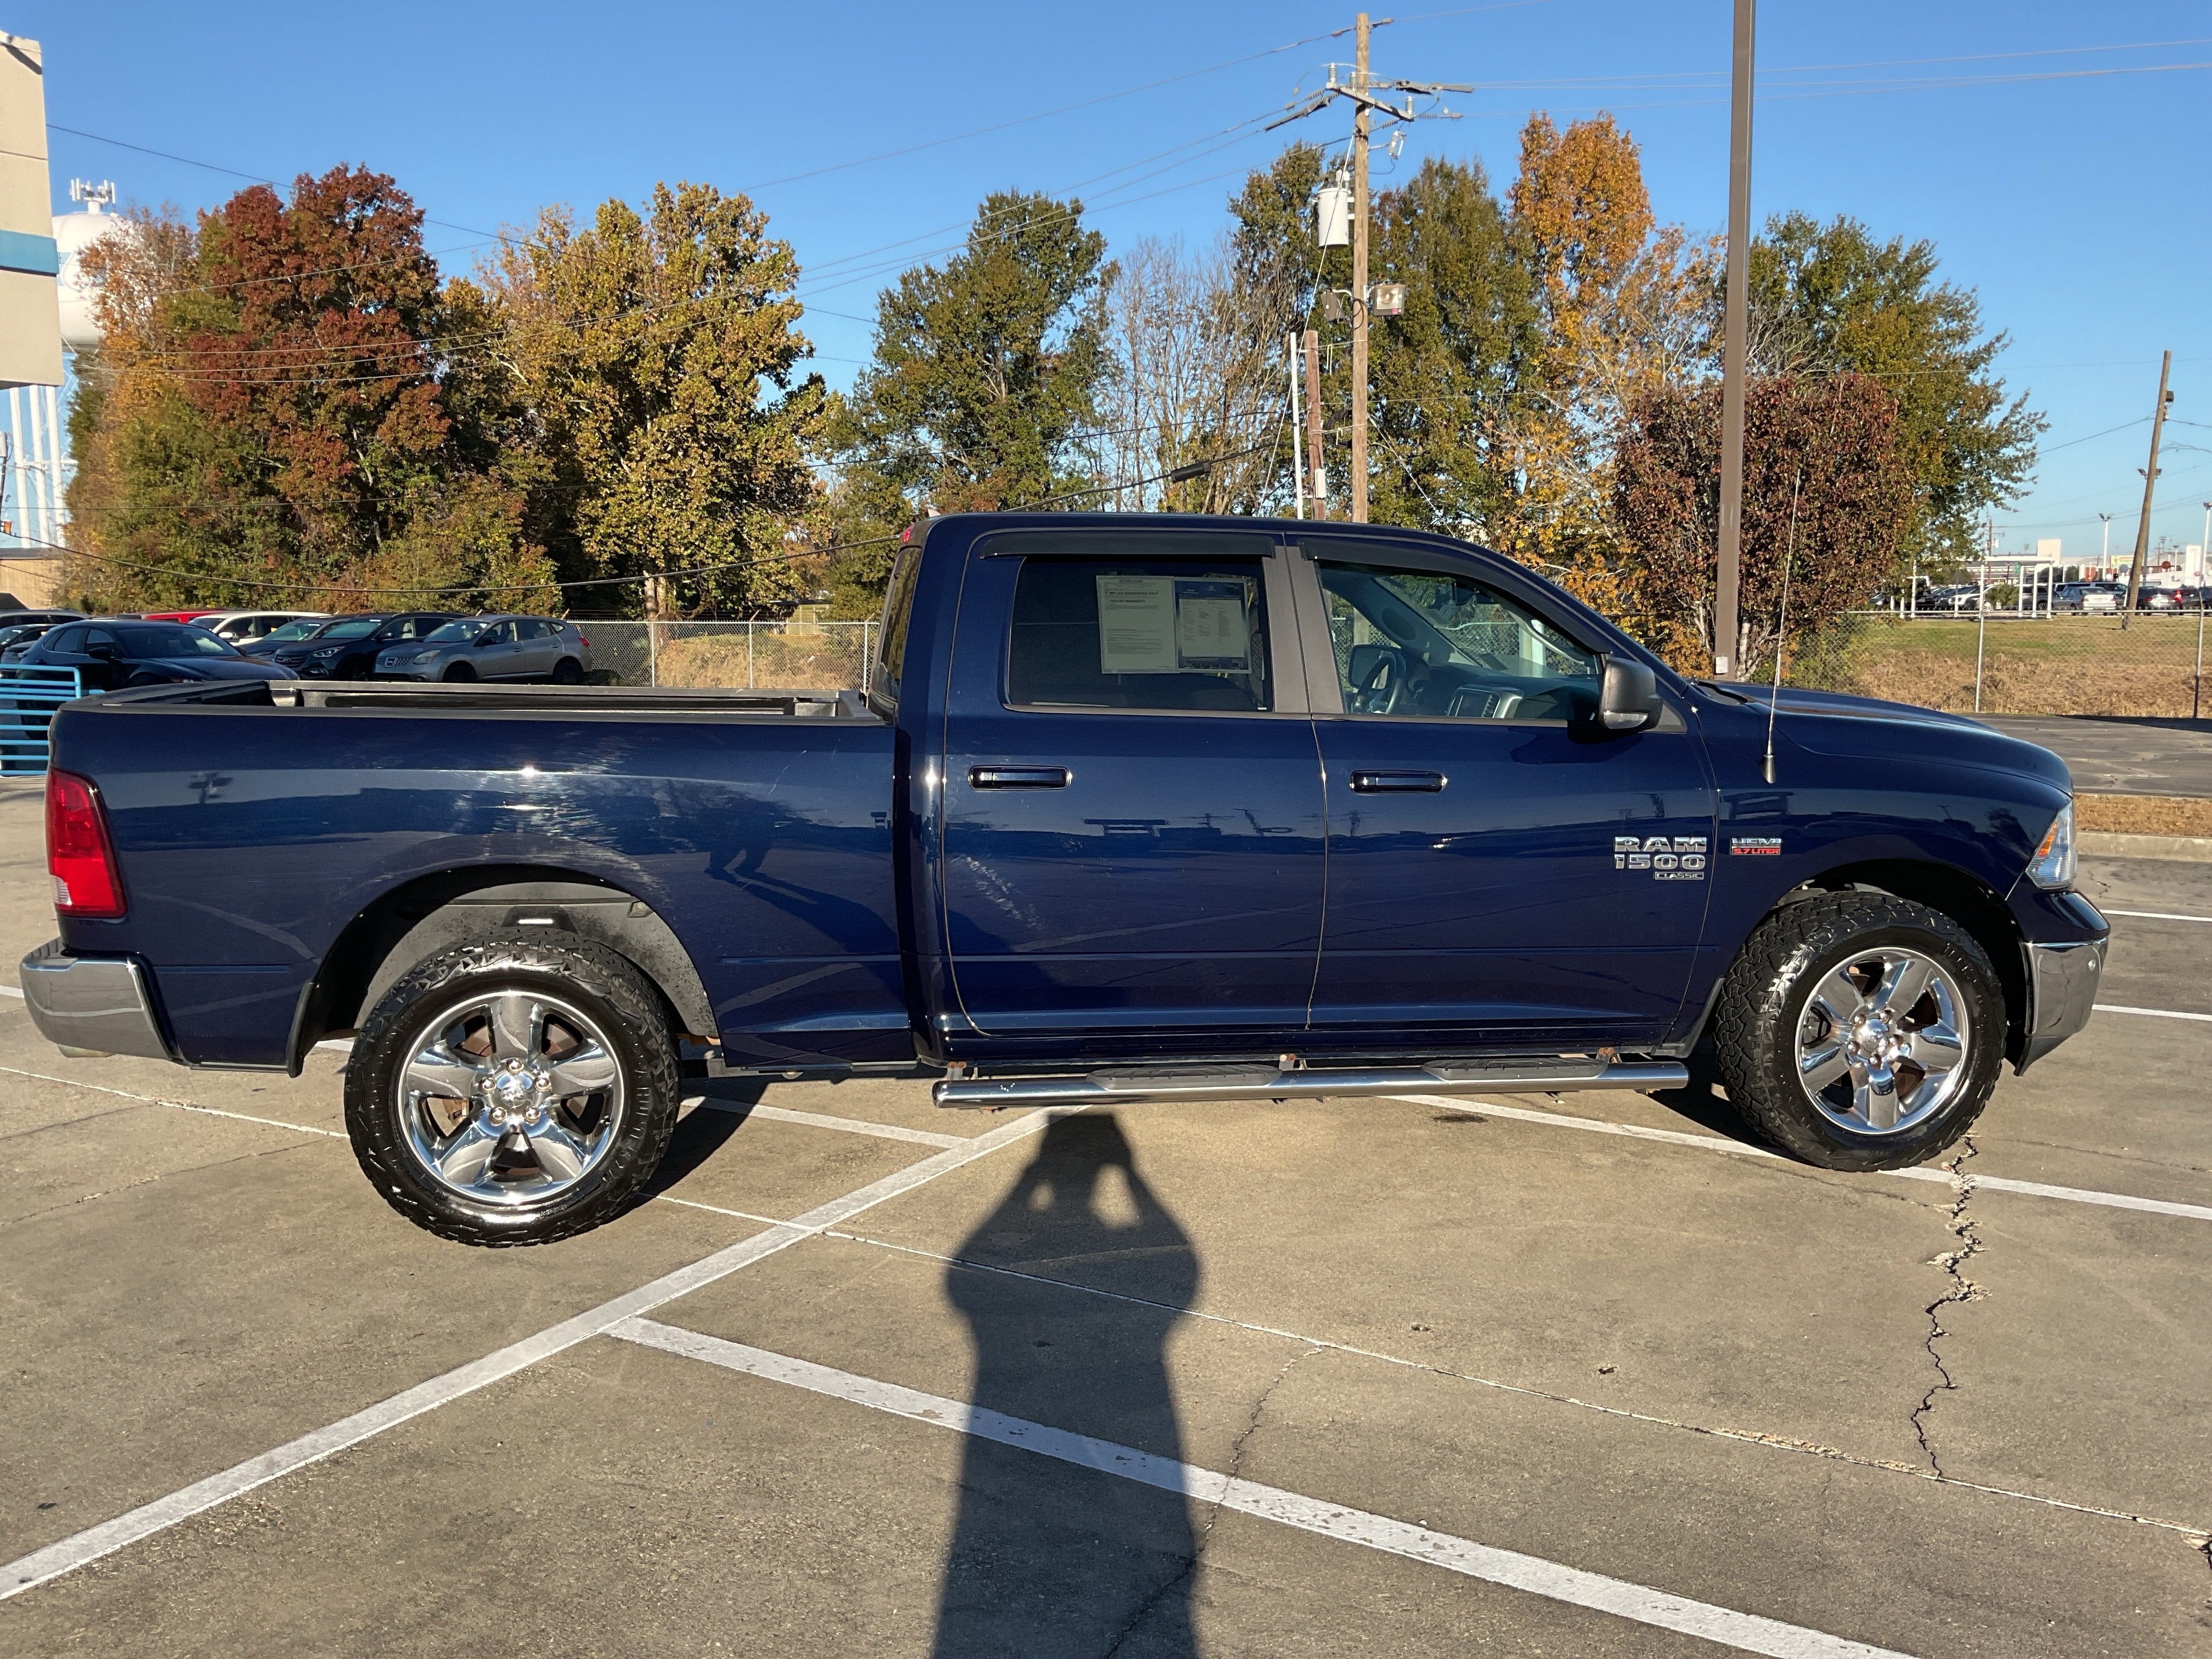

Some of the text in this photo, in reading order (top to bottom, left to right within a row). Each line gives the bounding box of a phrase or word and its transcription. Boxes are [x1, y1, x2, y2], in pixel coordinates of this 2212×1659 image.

[1614, 837, 1707, 853] RAM
[1732, 838, 1781, 847] HEMI
[1614, 854, 1706, 870] 1500
